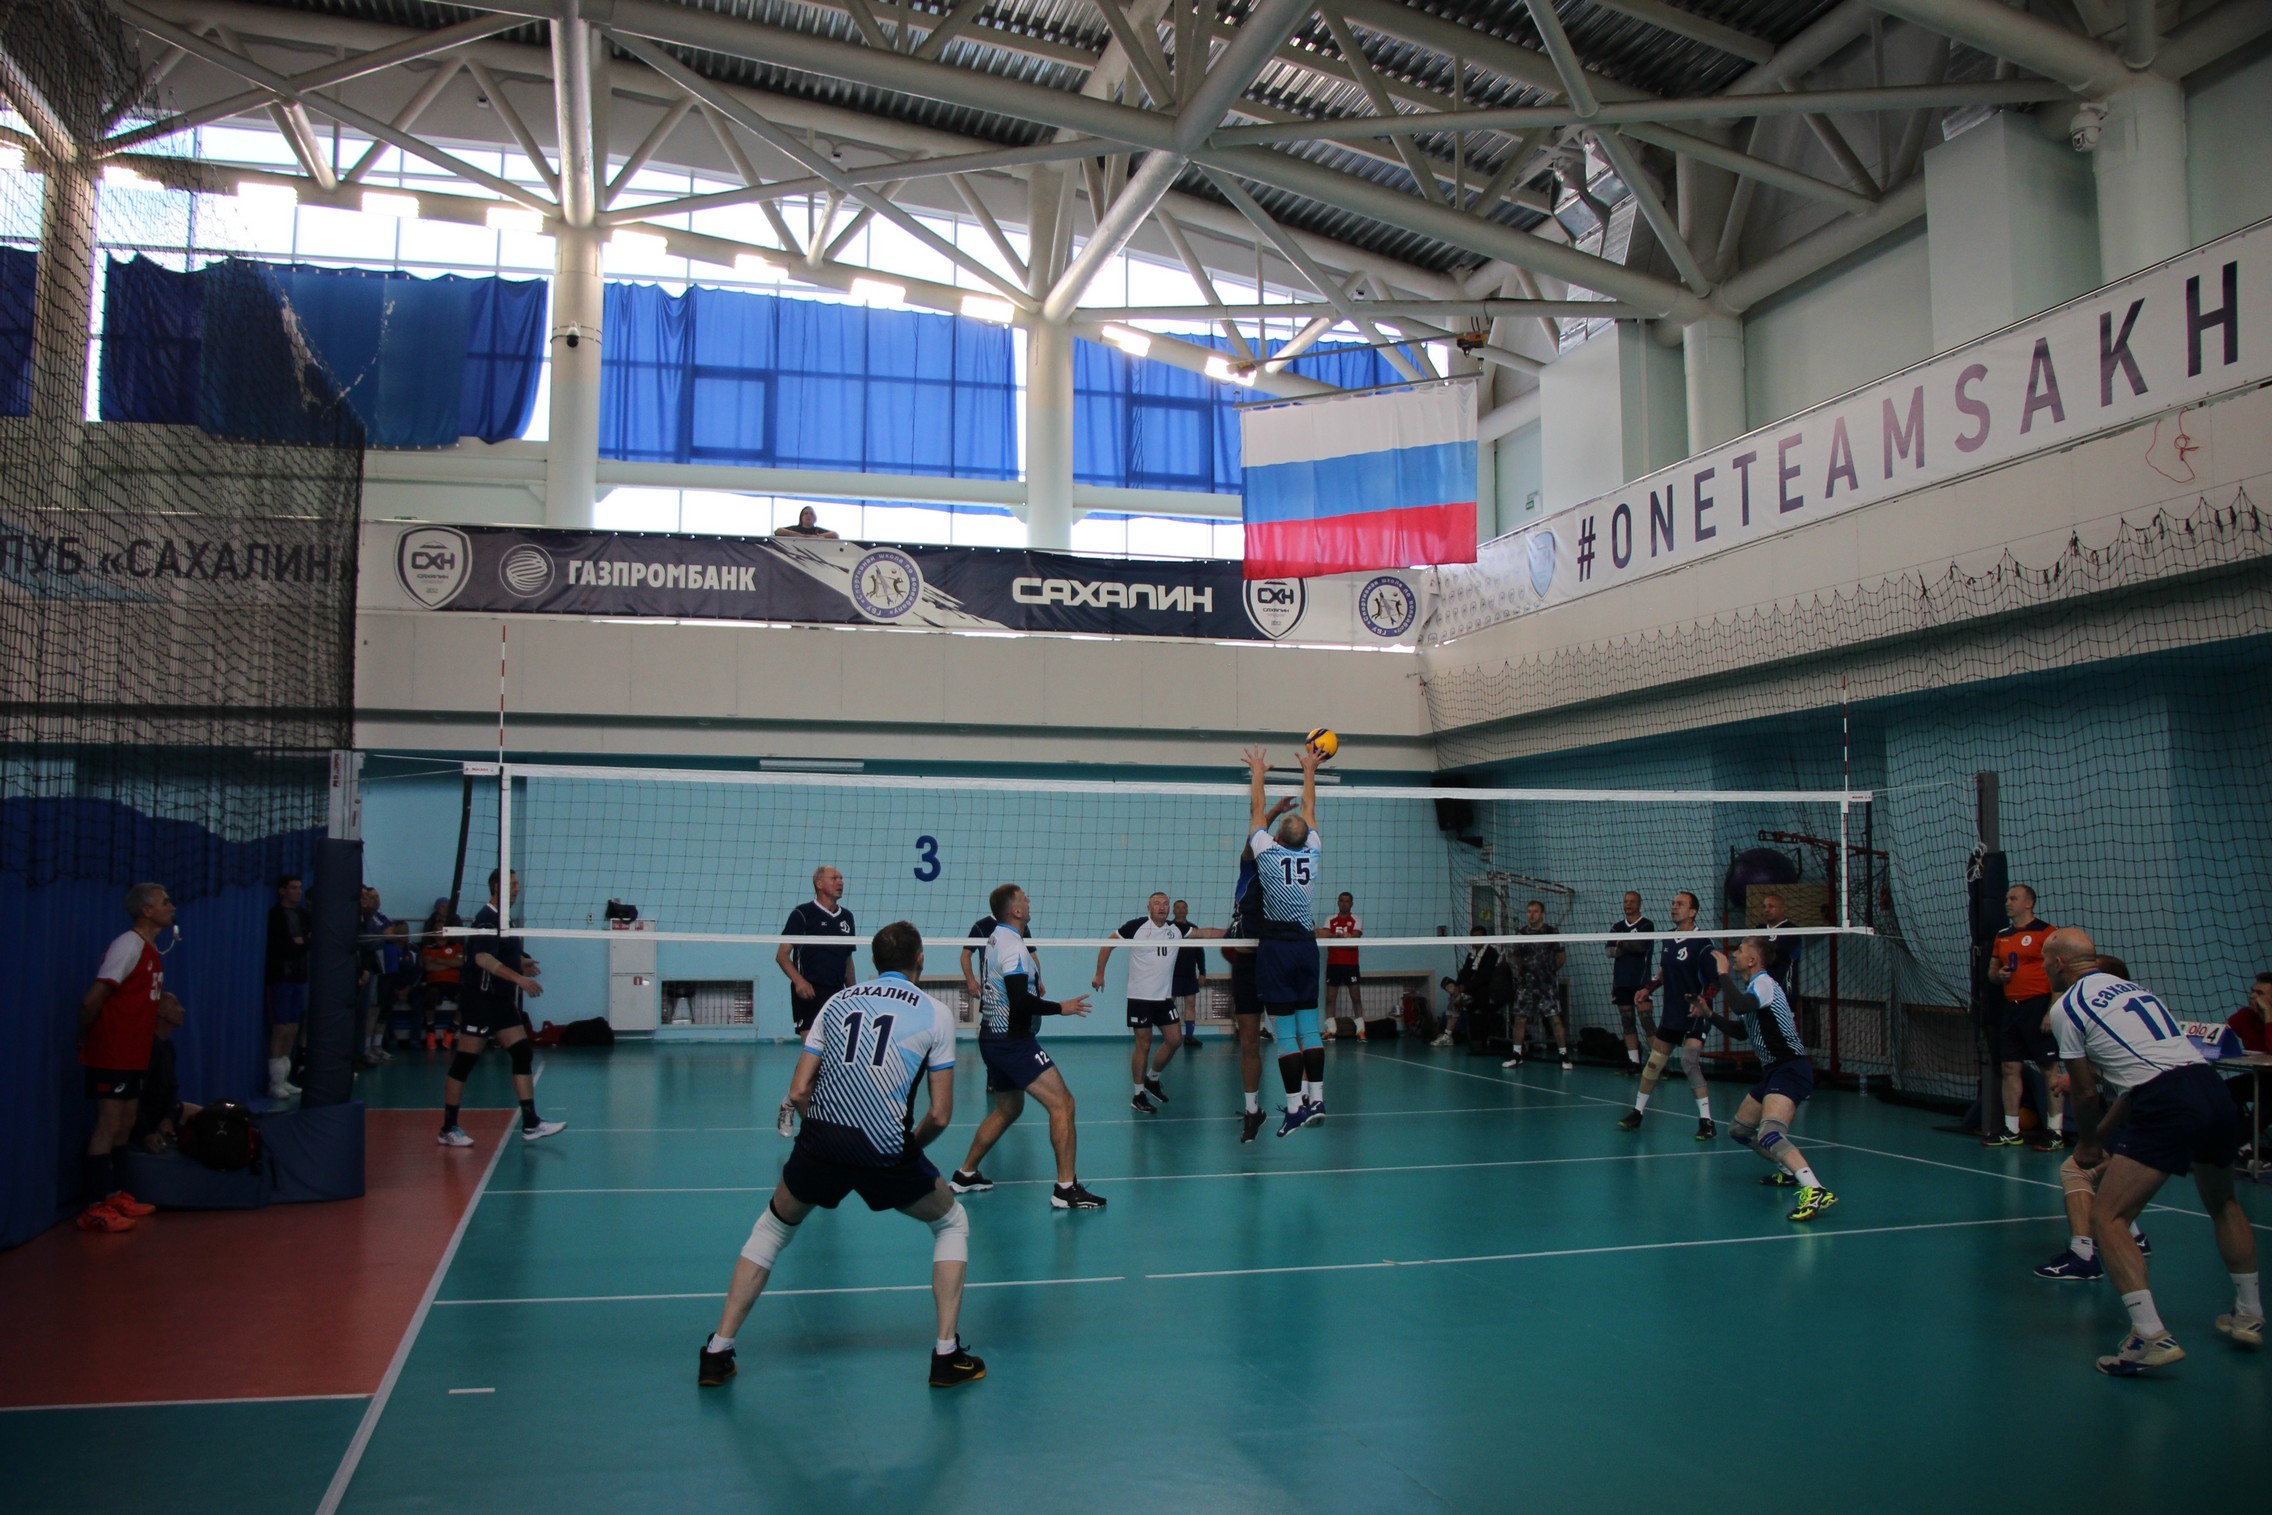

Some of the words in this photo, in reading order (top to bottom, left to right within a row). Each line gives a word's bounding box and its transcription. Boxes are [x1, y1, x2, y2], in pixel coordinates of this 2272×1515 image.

[1576, 260, 2239, 582] #ONETEAMSAKH
[568, 559, 757, 592] ГАЗПРОМБАНК
[904, 564, 914, 574] по
[1012, 577, 1213, 613] САХАЛИН
[913, 835, 941, 882] 3
[1280, 857, 1310, 885] 15
[842, 985, 920, 1007] САХАЛИН
[2122, 995, 2181, 1041] 17
[843, 1011, 895, 1067] 11
[1034, 1050, 1050, 1066] 12
